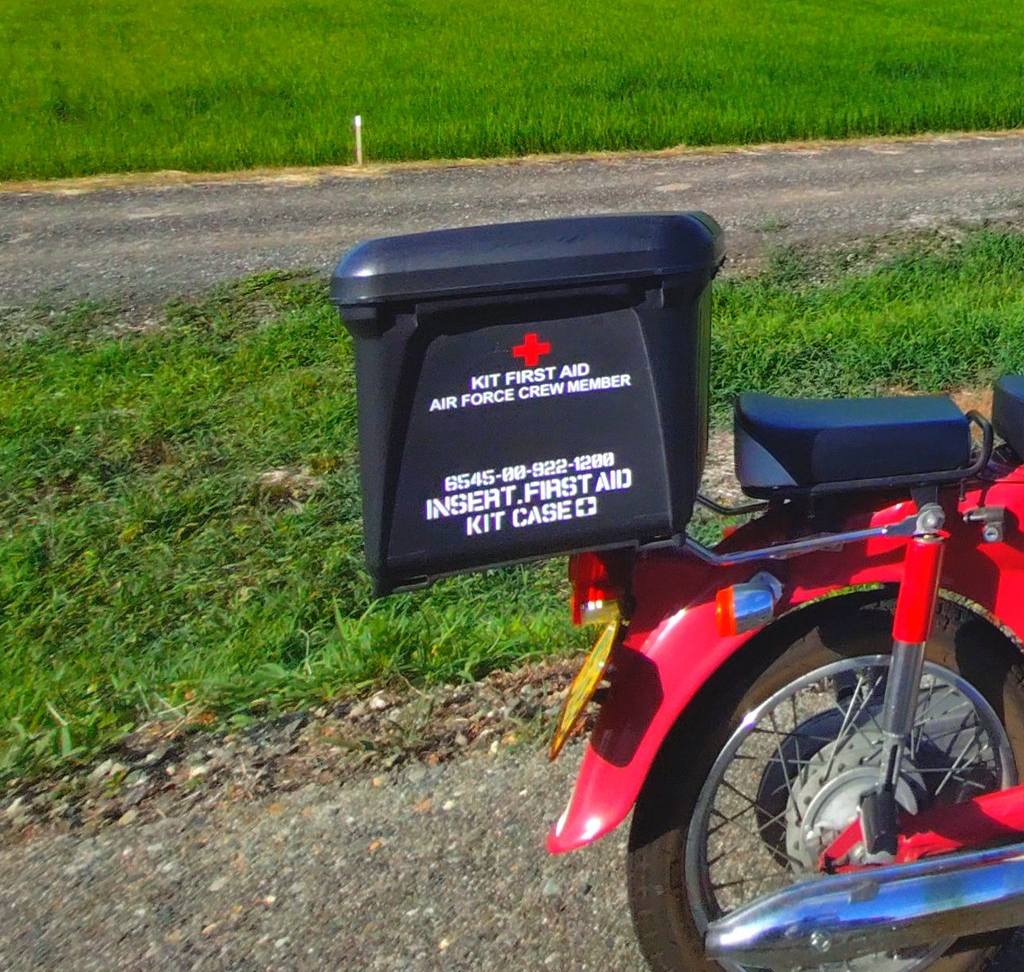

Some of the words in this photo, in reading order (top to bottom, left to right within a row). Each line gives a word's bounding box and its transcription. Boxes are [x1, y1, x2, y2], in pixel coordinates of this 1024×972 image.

[429, 395, 458, 412] AIR
[461, 388, 515, 407] FORCE
[518, 381, 564, 400] CREW
[567, 374, 631, 393] MEMBER
[471, 373, 501, 390] KIT
[505, 366, 557, 386] FIRST
[559, 362, 590, 379] AID
[444, 451, 615, 492] 6545-00-922-1200
[595, 468, 632, 493] AID
[466, 511, 505, 536] KIT
[512, 500, 572, 528] CASE
